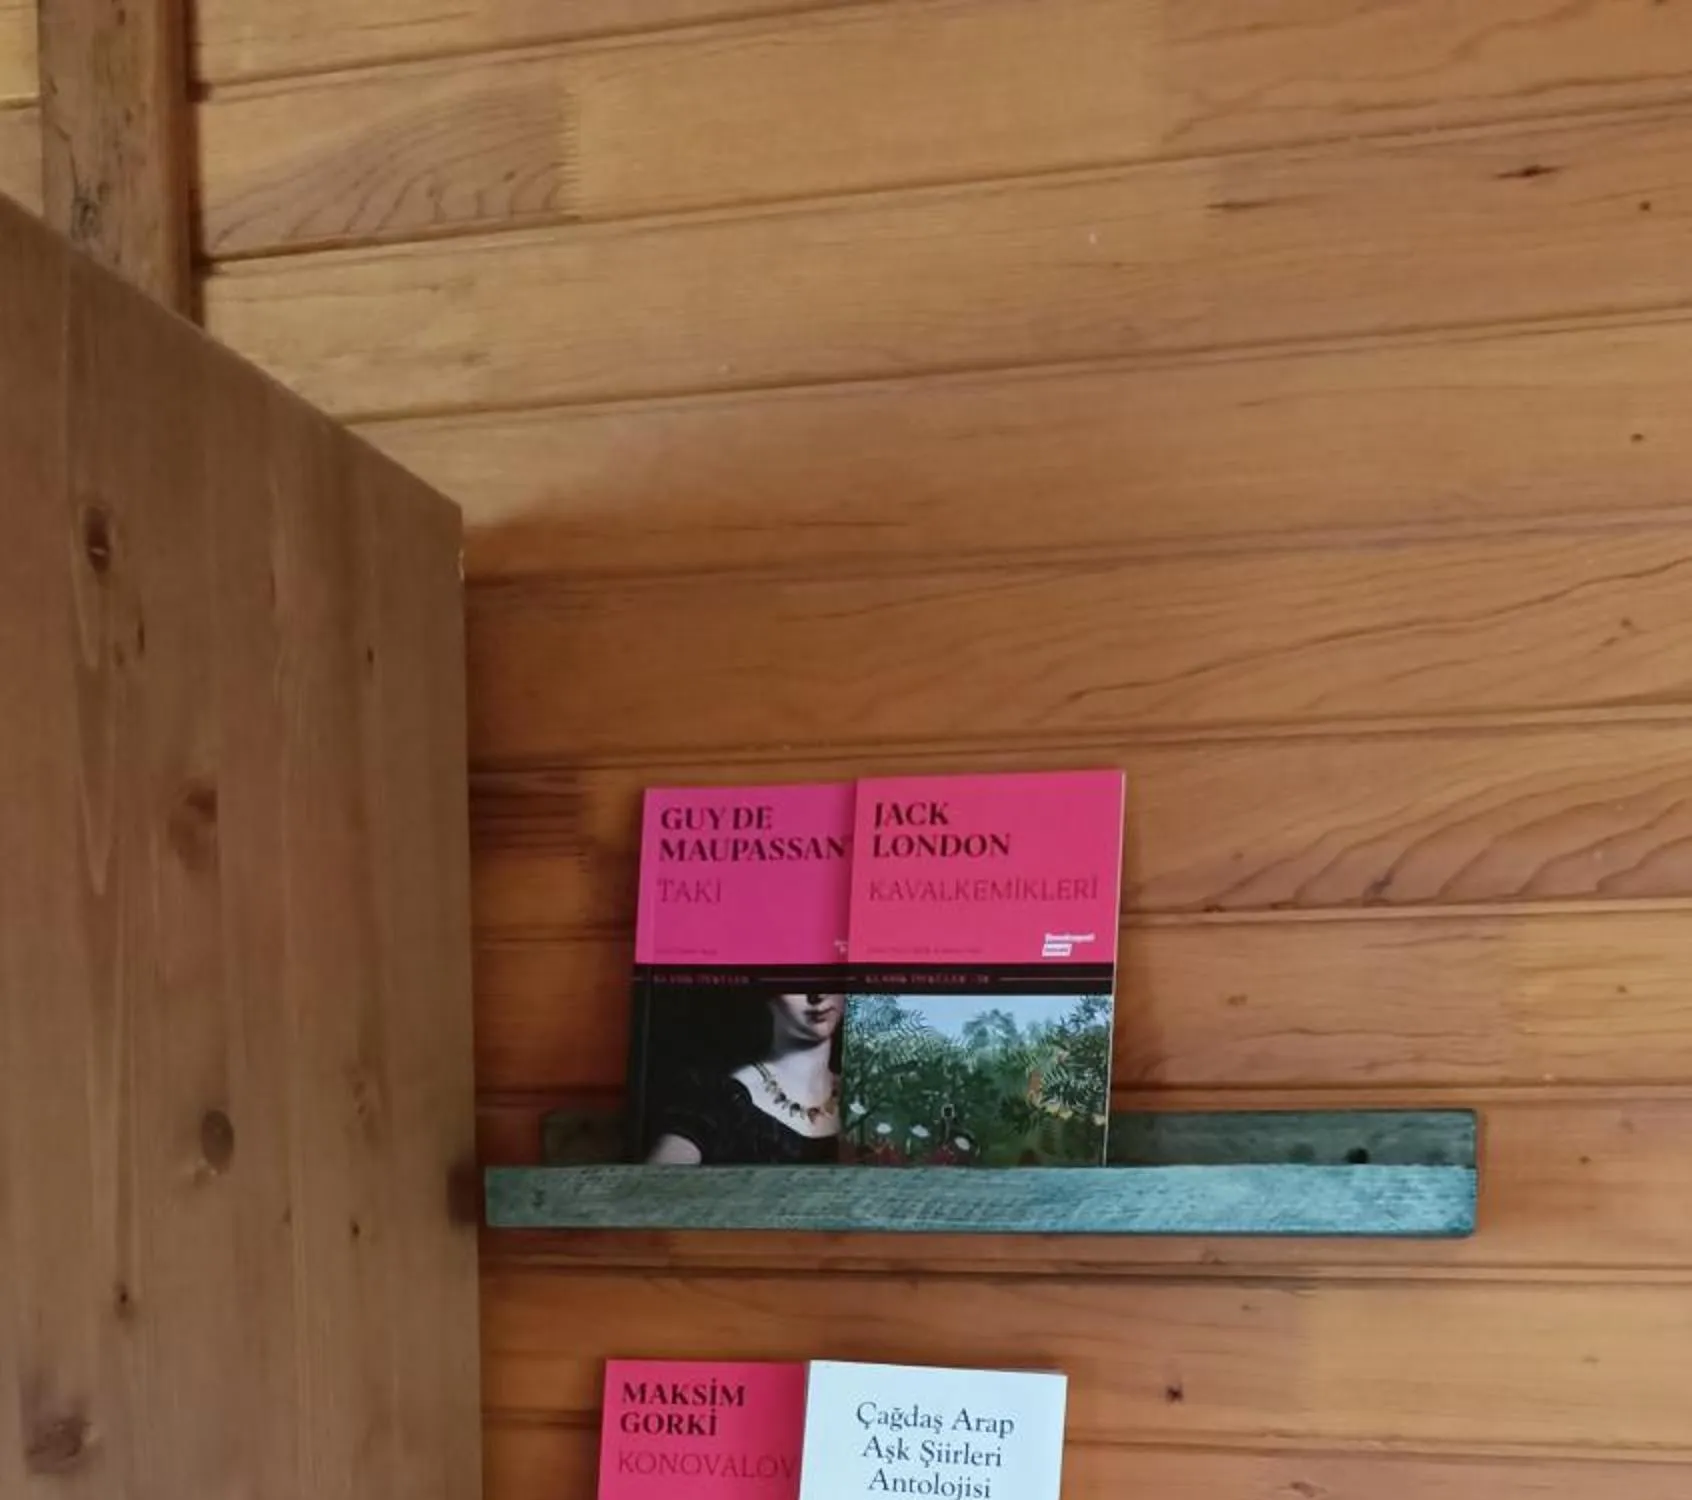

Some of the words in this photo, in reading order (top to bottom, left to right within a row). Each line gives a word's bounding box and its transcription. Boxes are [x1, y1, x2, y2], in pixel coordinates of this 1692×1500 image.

[660, 806, 731, 831] GUY
[732, 805, 773, 830] DE
[873, 800, 949, 828] JACK
[658, 836, 853, 862] MAUPASSAN
[871, 833, 1011, 859] LONDON
[622, 1377, 746, 1407] MAKSİM
[619, 1408, 717, 1436] GORKİ
[856, 1401, 944, 1434] Çağdaş
[951, 1407, 1015, 1439] Arap
[618, 1451, 799, 1479] KONOVALOV
[862, 1436, 910, 1464] Aşk
[919, 1439, 1002, 1468] Şiirleri
